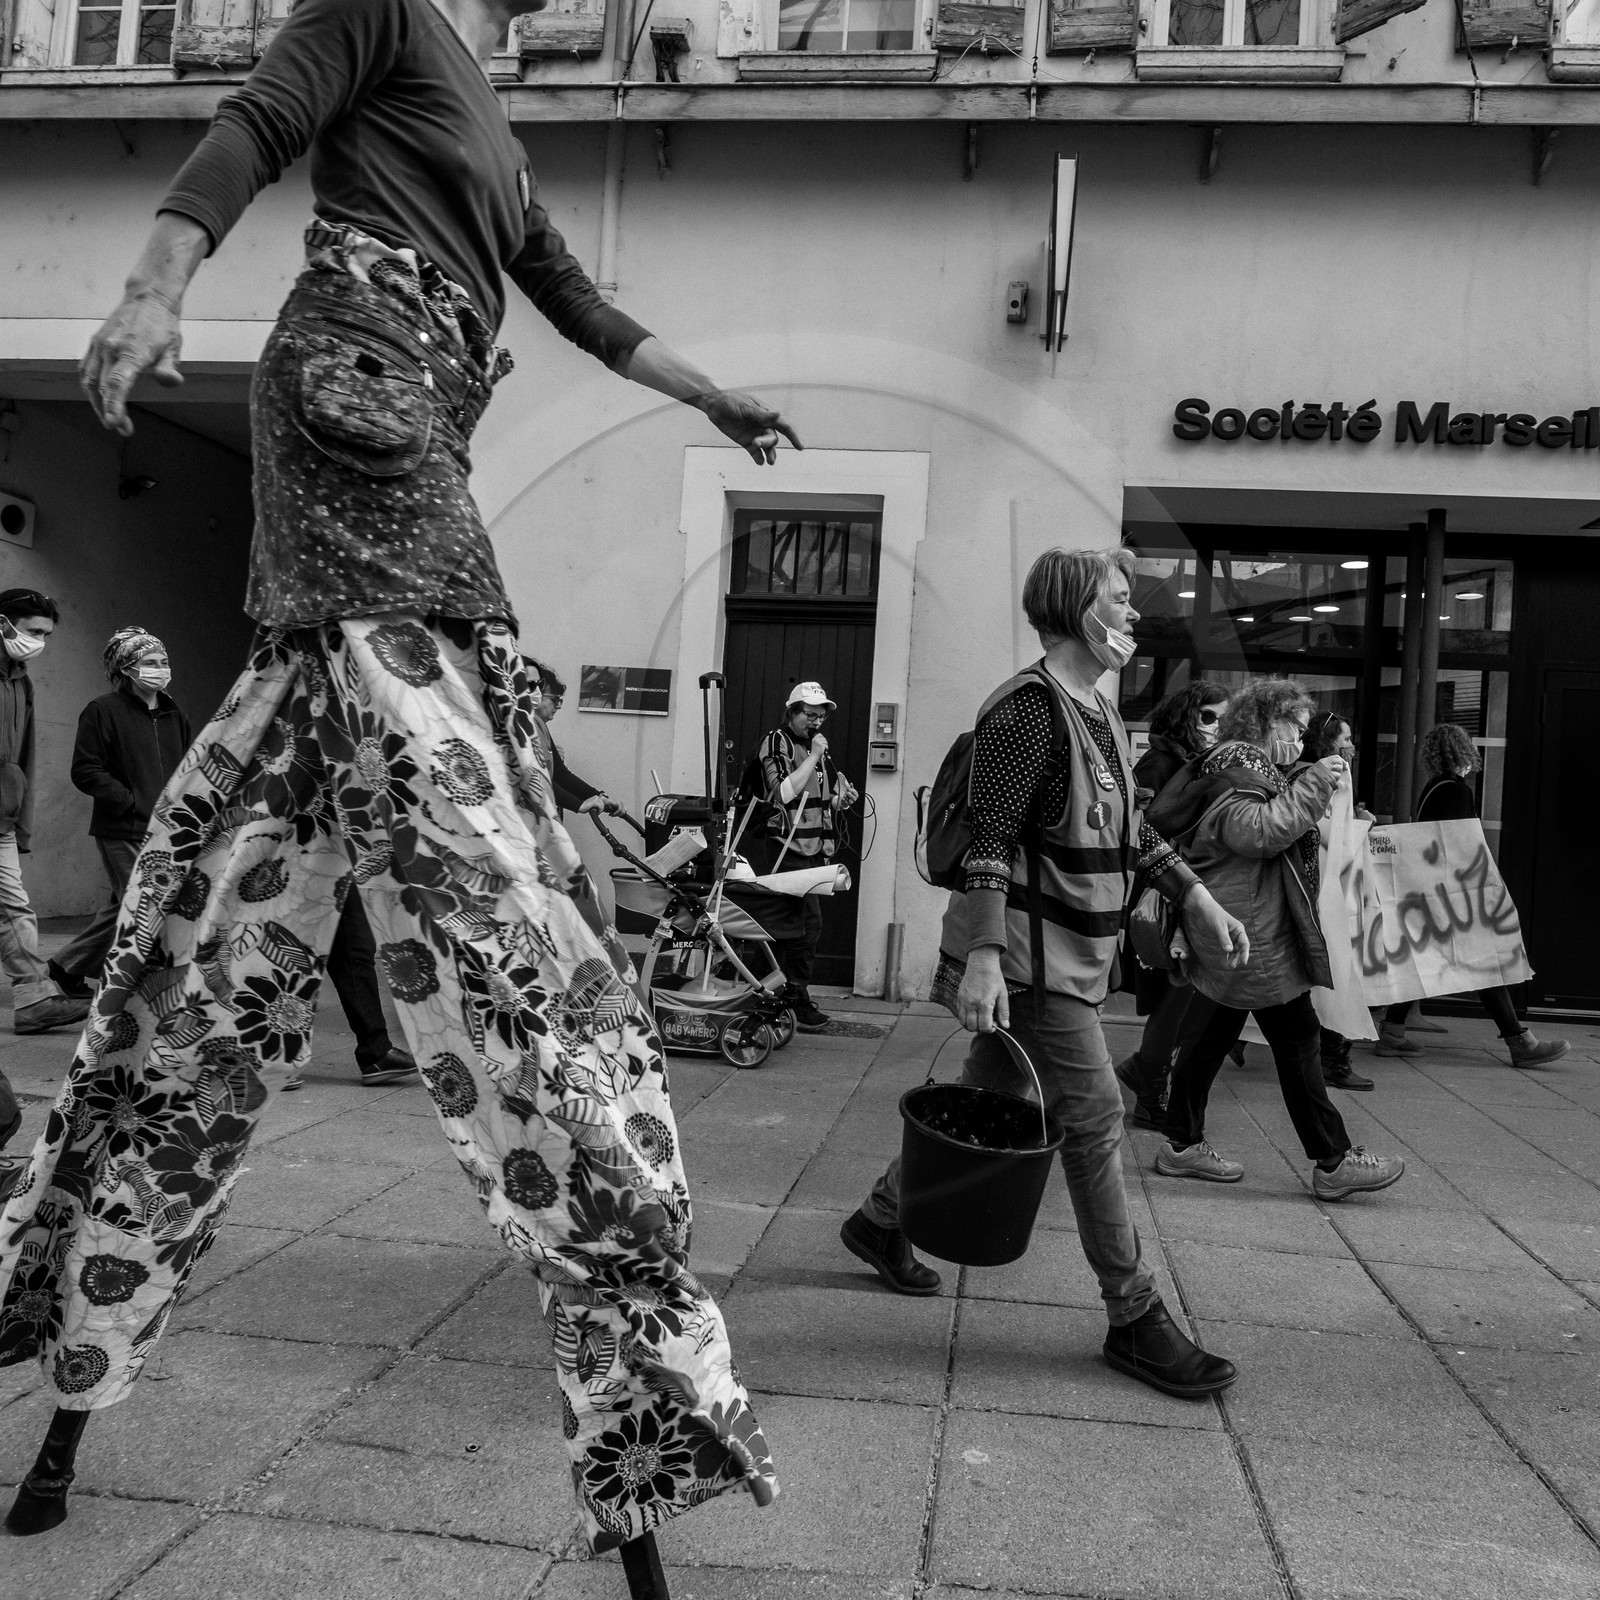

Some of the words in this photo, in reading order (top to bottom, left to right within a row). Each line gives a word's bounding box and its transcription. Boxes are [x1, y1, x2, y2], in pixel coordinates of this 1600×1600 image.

[1172, 398, 1382, 443] Société
[672, 941, 694, 950] MERC
[665, 1022, 716, 1038] BABY-MERC
